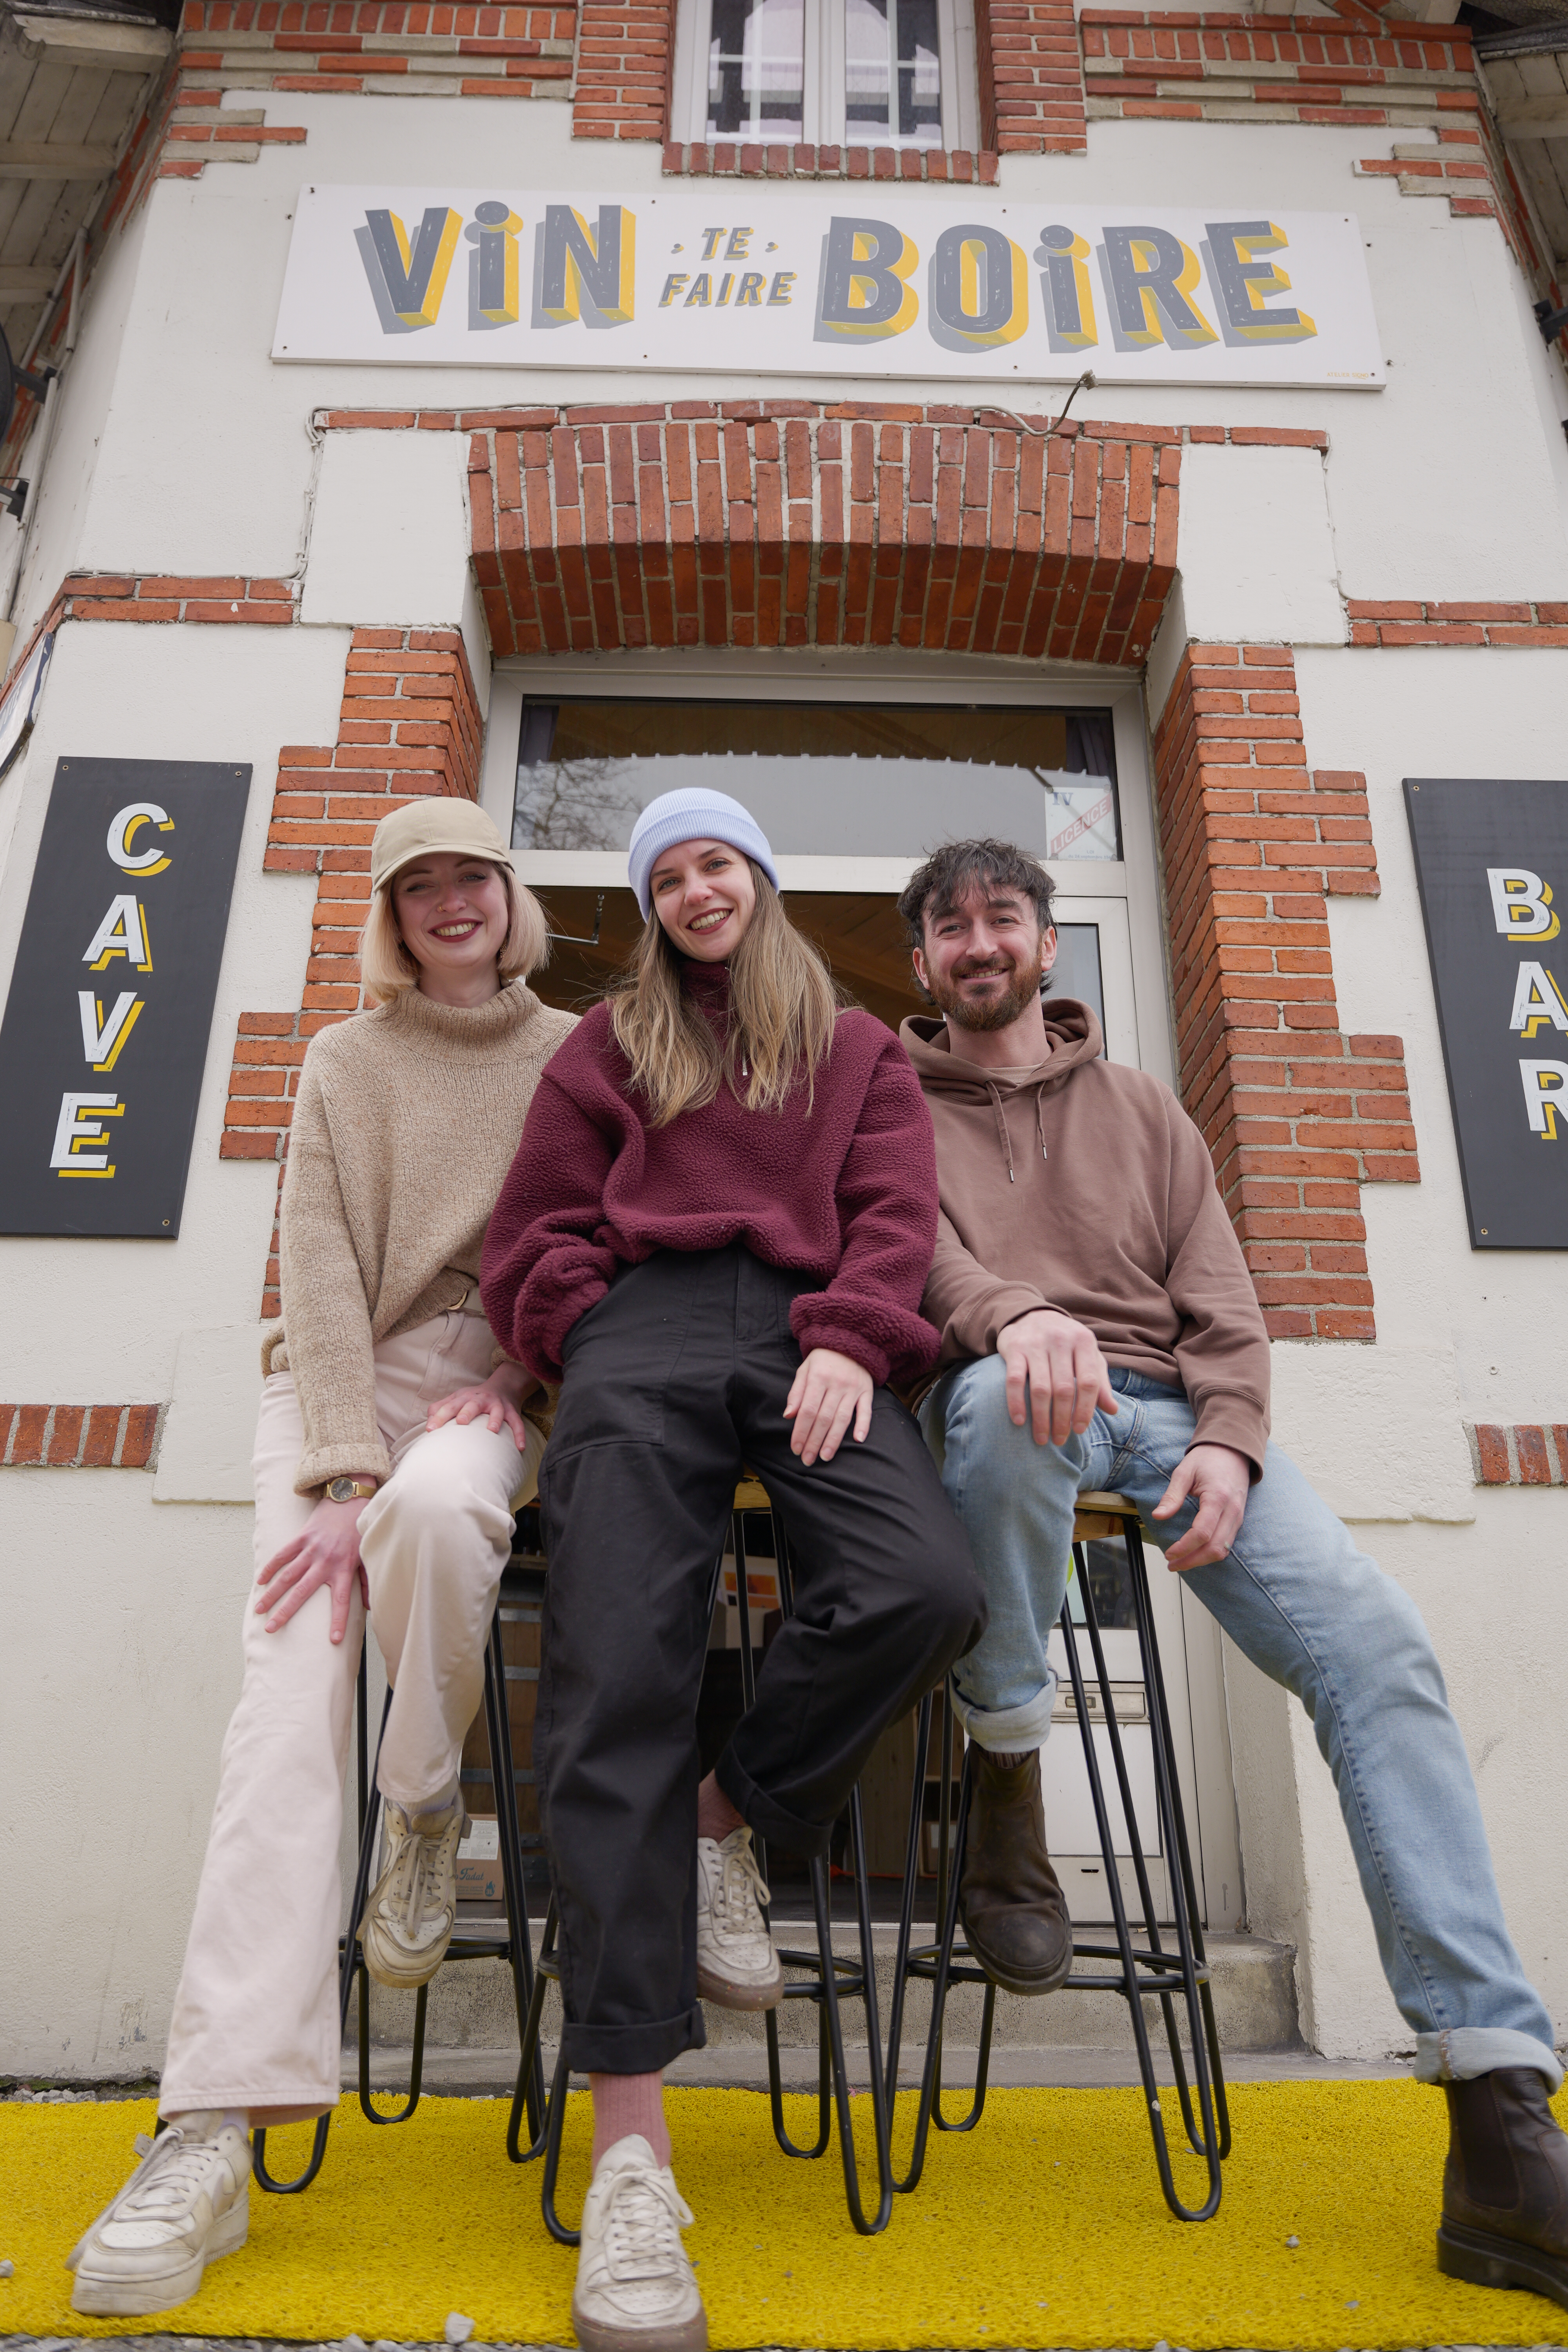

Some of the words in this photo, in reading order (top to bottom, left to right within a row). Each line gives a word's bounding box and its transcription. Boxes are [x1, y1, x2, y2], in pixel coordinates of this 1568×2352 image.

[701, 227, 754, 261] TE
[658, 272, 797, 307] FAIRE
[1053, 792, 1073, 806] IV
[1054, 799, 1107, 853] LICENCE
[49, 803, 175, 1178] CAVE
[1487, 868, 1568, 1140] BAR
[459, 1867, 484, 1880] Fadat
